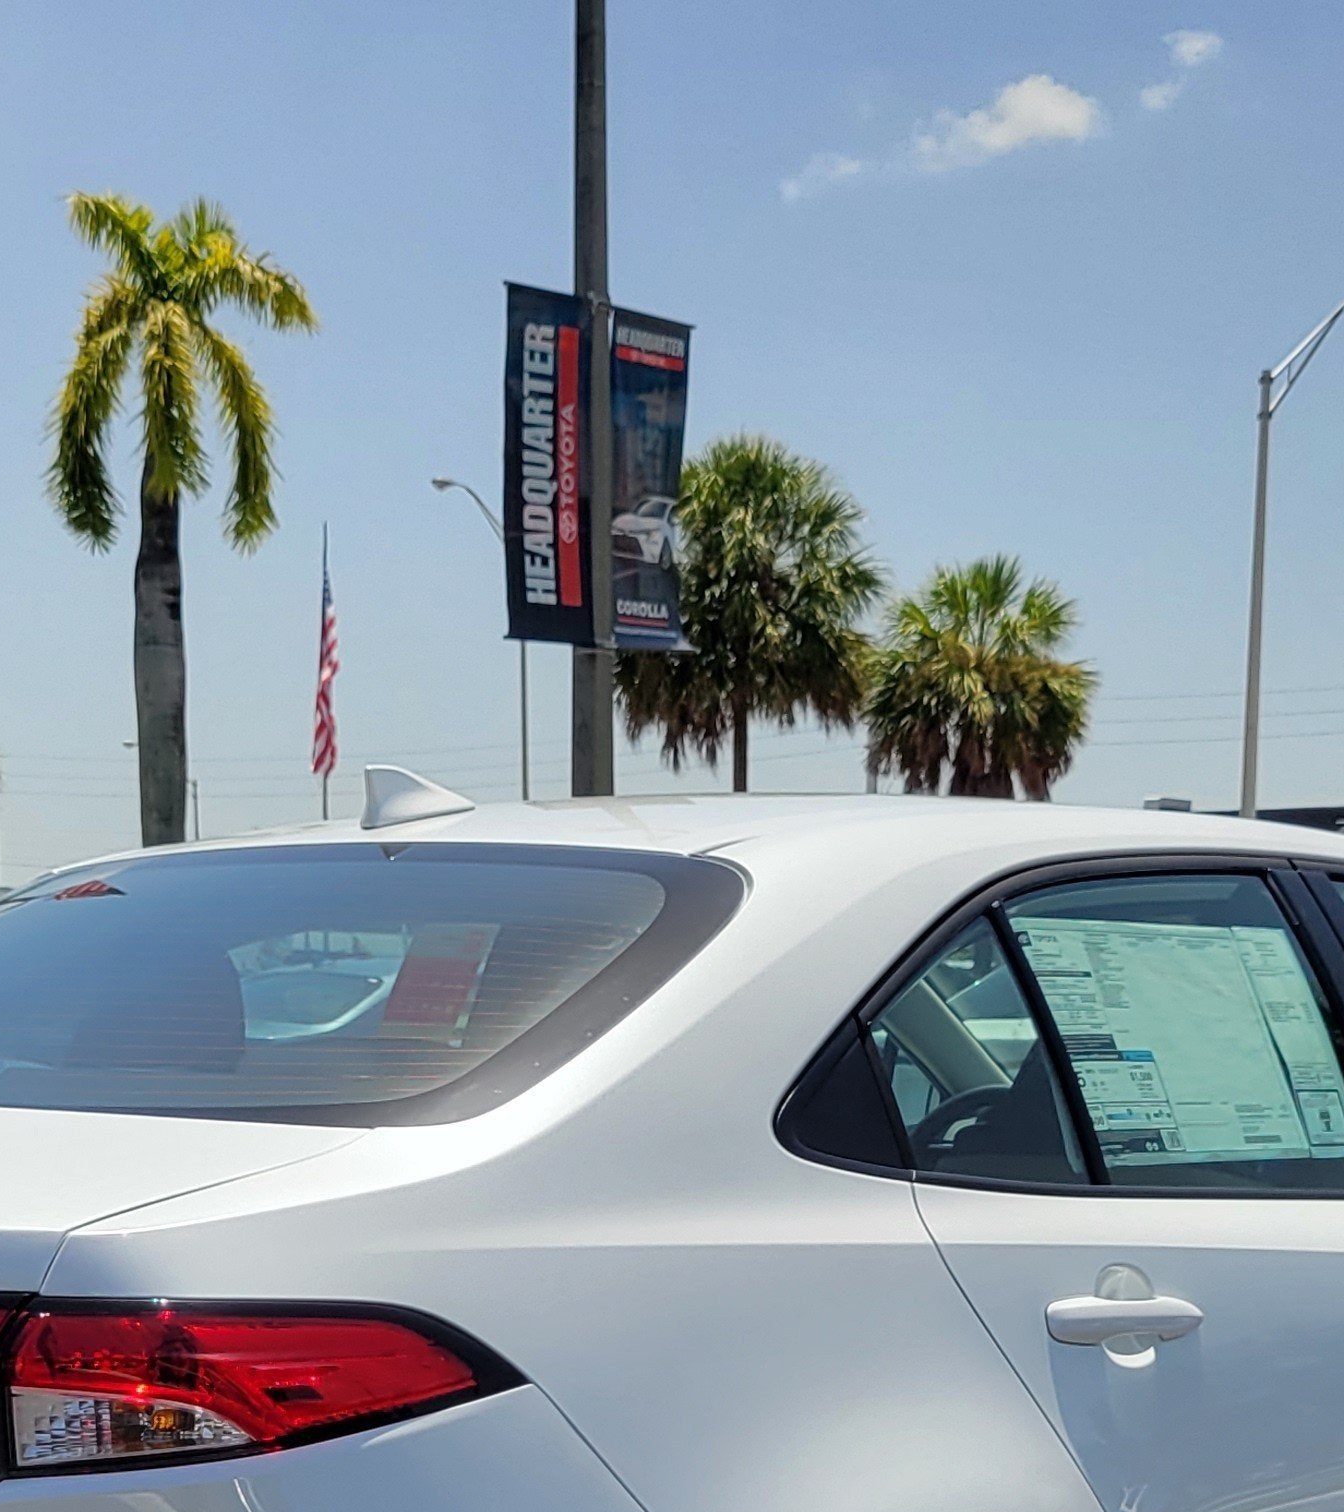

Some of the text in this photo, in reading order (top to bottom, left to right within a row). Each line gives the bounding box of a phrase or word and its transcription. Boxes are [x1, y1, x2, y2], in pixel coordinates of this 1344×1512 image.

[522, 322, 558, 606] HEADQUARTER
[560, 404, 576, 508] TOYOTA
[617, 599, 668, 620] COROLLA
